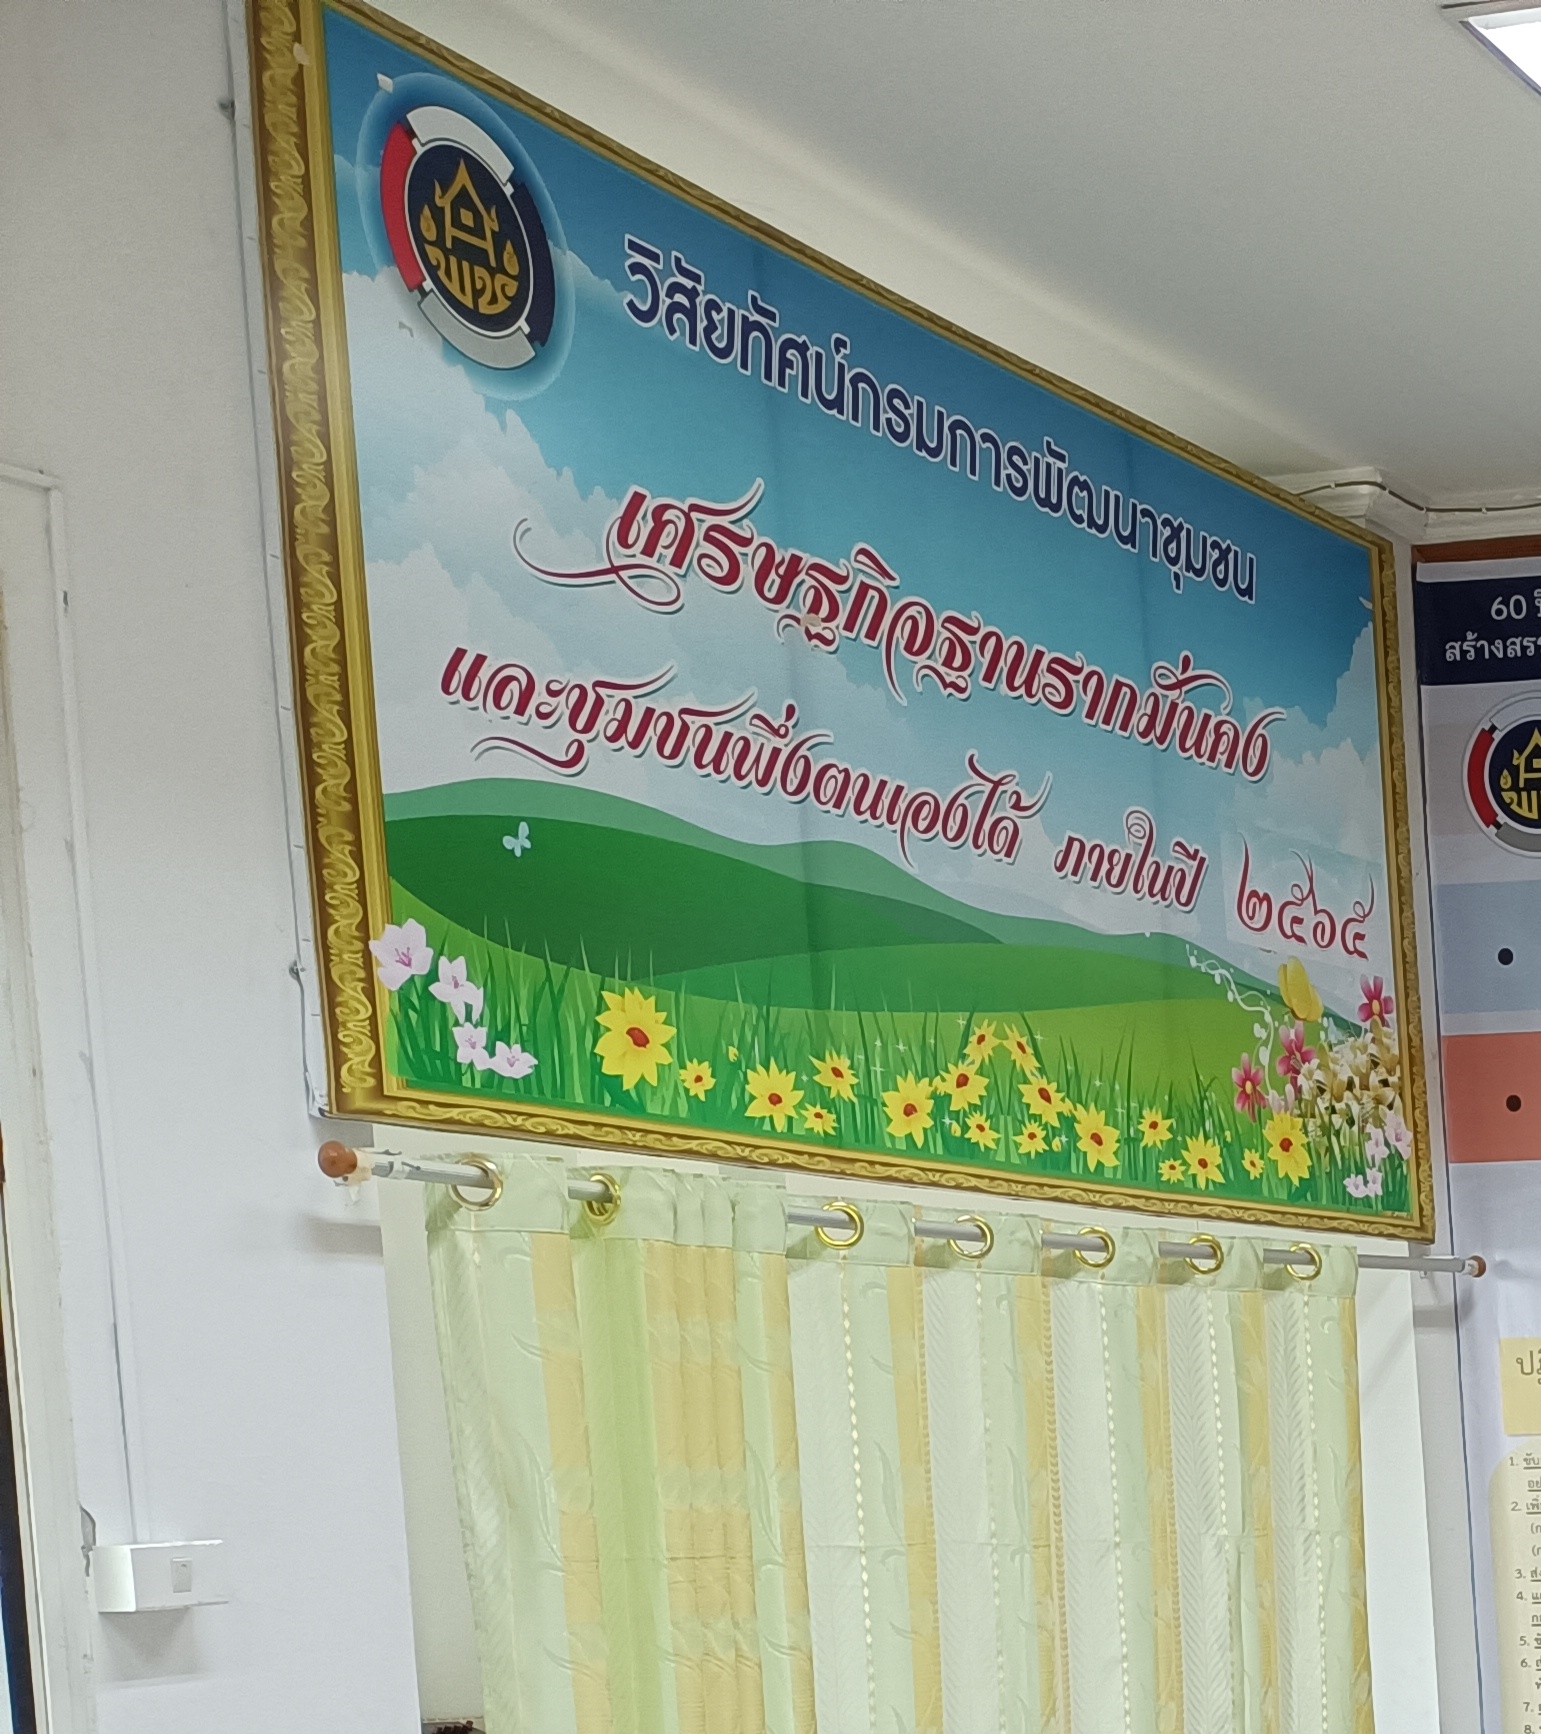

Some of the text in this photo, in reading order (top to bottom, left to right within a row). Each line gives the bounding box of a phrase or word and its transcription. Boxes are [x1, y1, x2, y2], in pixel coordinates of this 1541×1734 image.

[622, 232, 1257, 605] วิสัยทัศน์กรมการพัฒนาชุมชน
[514, 478, 1287, 782] เศรษฐกิจฐานรากมั่นคง
[1491, 596, 1527, 621] 60
[440, 647, 1375, 962] และชุมชนพึ่งตนเองได้ ภายในปี ๒๕๖๕
